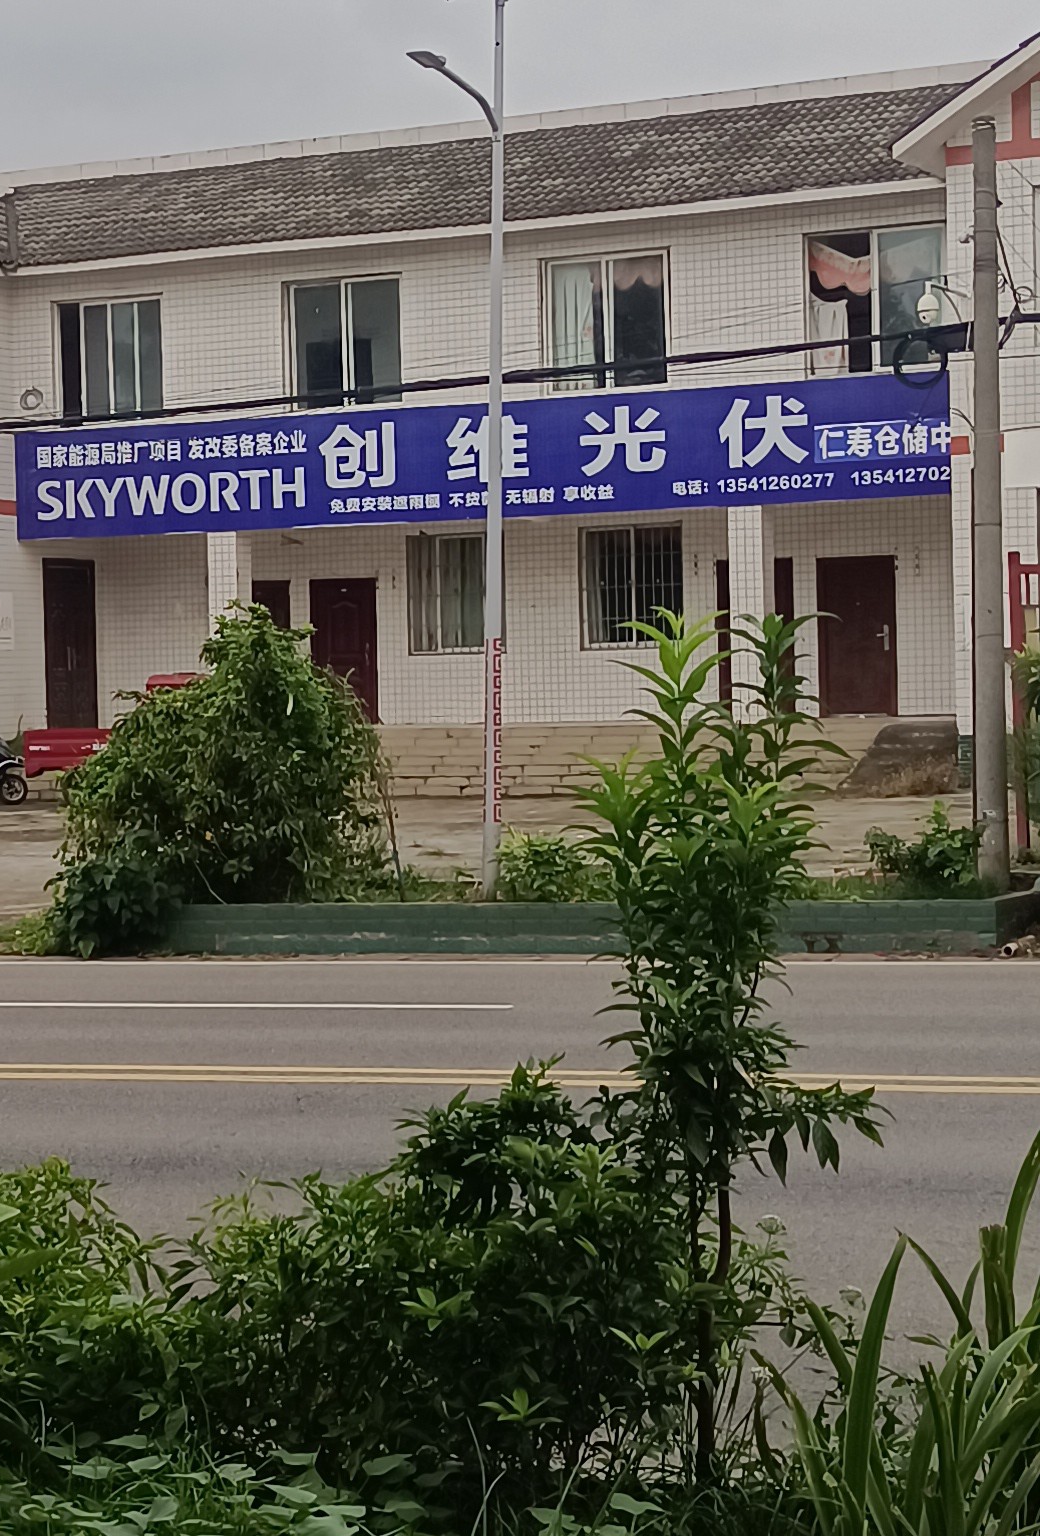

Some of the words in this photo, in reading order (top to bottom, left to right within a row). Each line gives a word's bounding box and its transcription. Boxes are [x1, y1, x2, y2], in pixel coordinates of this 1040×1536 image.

[36, 439, 182, 469] 国家能源局推广项目
[188, 429, 307, 461] 发改委备案企业
[319, 395, 809, 489] 创维光伏
[819, 421, 951, 460] 仁寿仓储中
[37, 466, 306, 521] SKYWORTH
[717, 472, 835, 493] 13541260277
